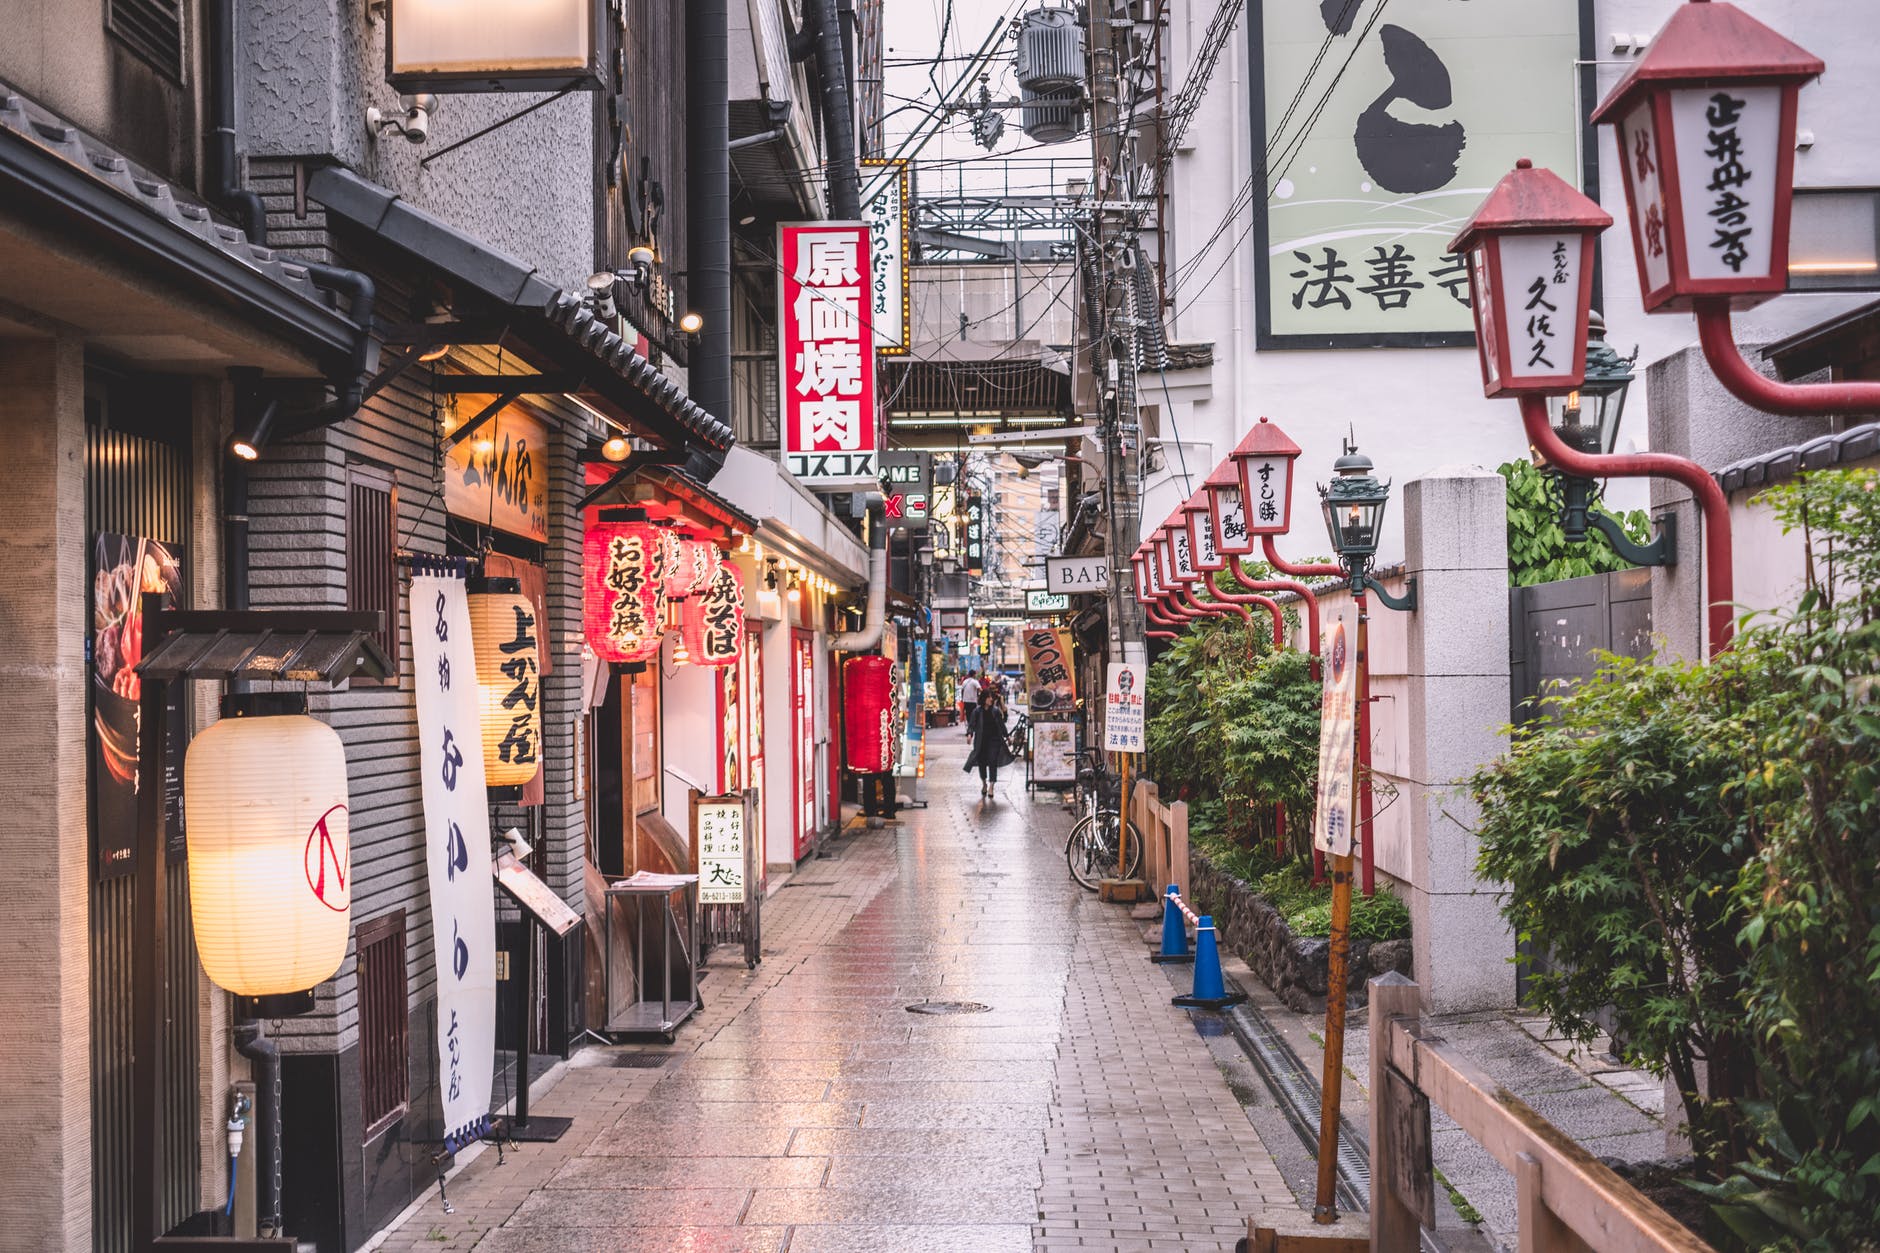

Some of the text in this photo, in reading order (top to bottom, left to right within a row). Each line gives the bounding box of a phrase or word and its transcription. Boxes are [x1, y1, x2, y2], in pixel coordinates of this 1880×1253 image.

[872, 190, 894, 314] 串かつだるま
[1552, 241, 1570, 284] 上かん屋
[793, 231, 863, 452] 原価焼肉
[1525, 276, 1558, 369] 久佐久
[788, 453, 874, 477] コスコス
[1257, 462, 1279, 522] すし勝
[1062, 565, 1107, 584] BAR
[702, 569, 738, 656] 焼そば
[498, 605, 538, 765] 上かん屋
[1028, 632, 1068, 686] もつ鍋
[1110, 733, 1138, 747] 法善寺
[704, 812, 713, 853] 一品料理
[710, 863, 742, 886] 大たこ
